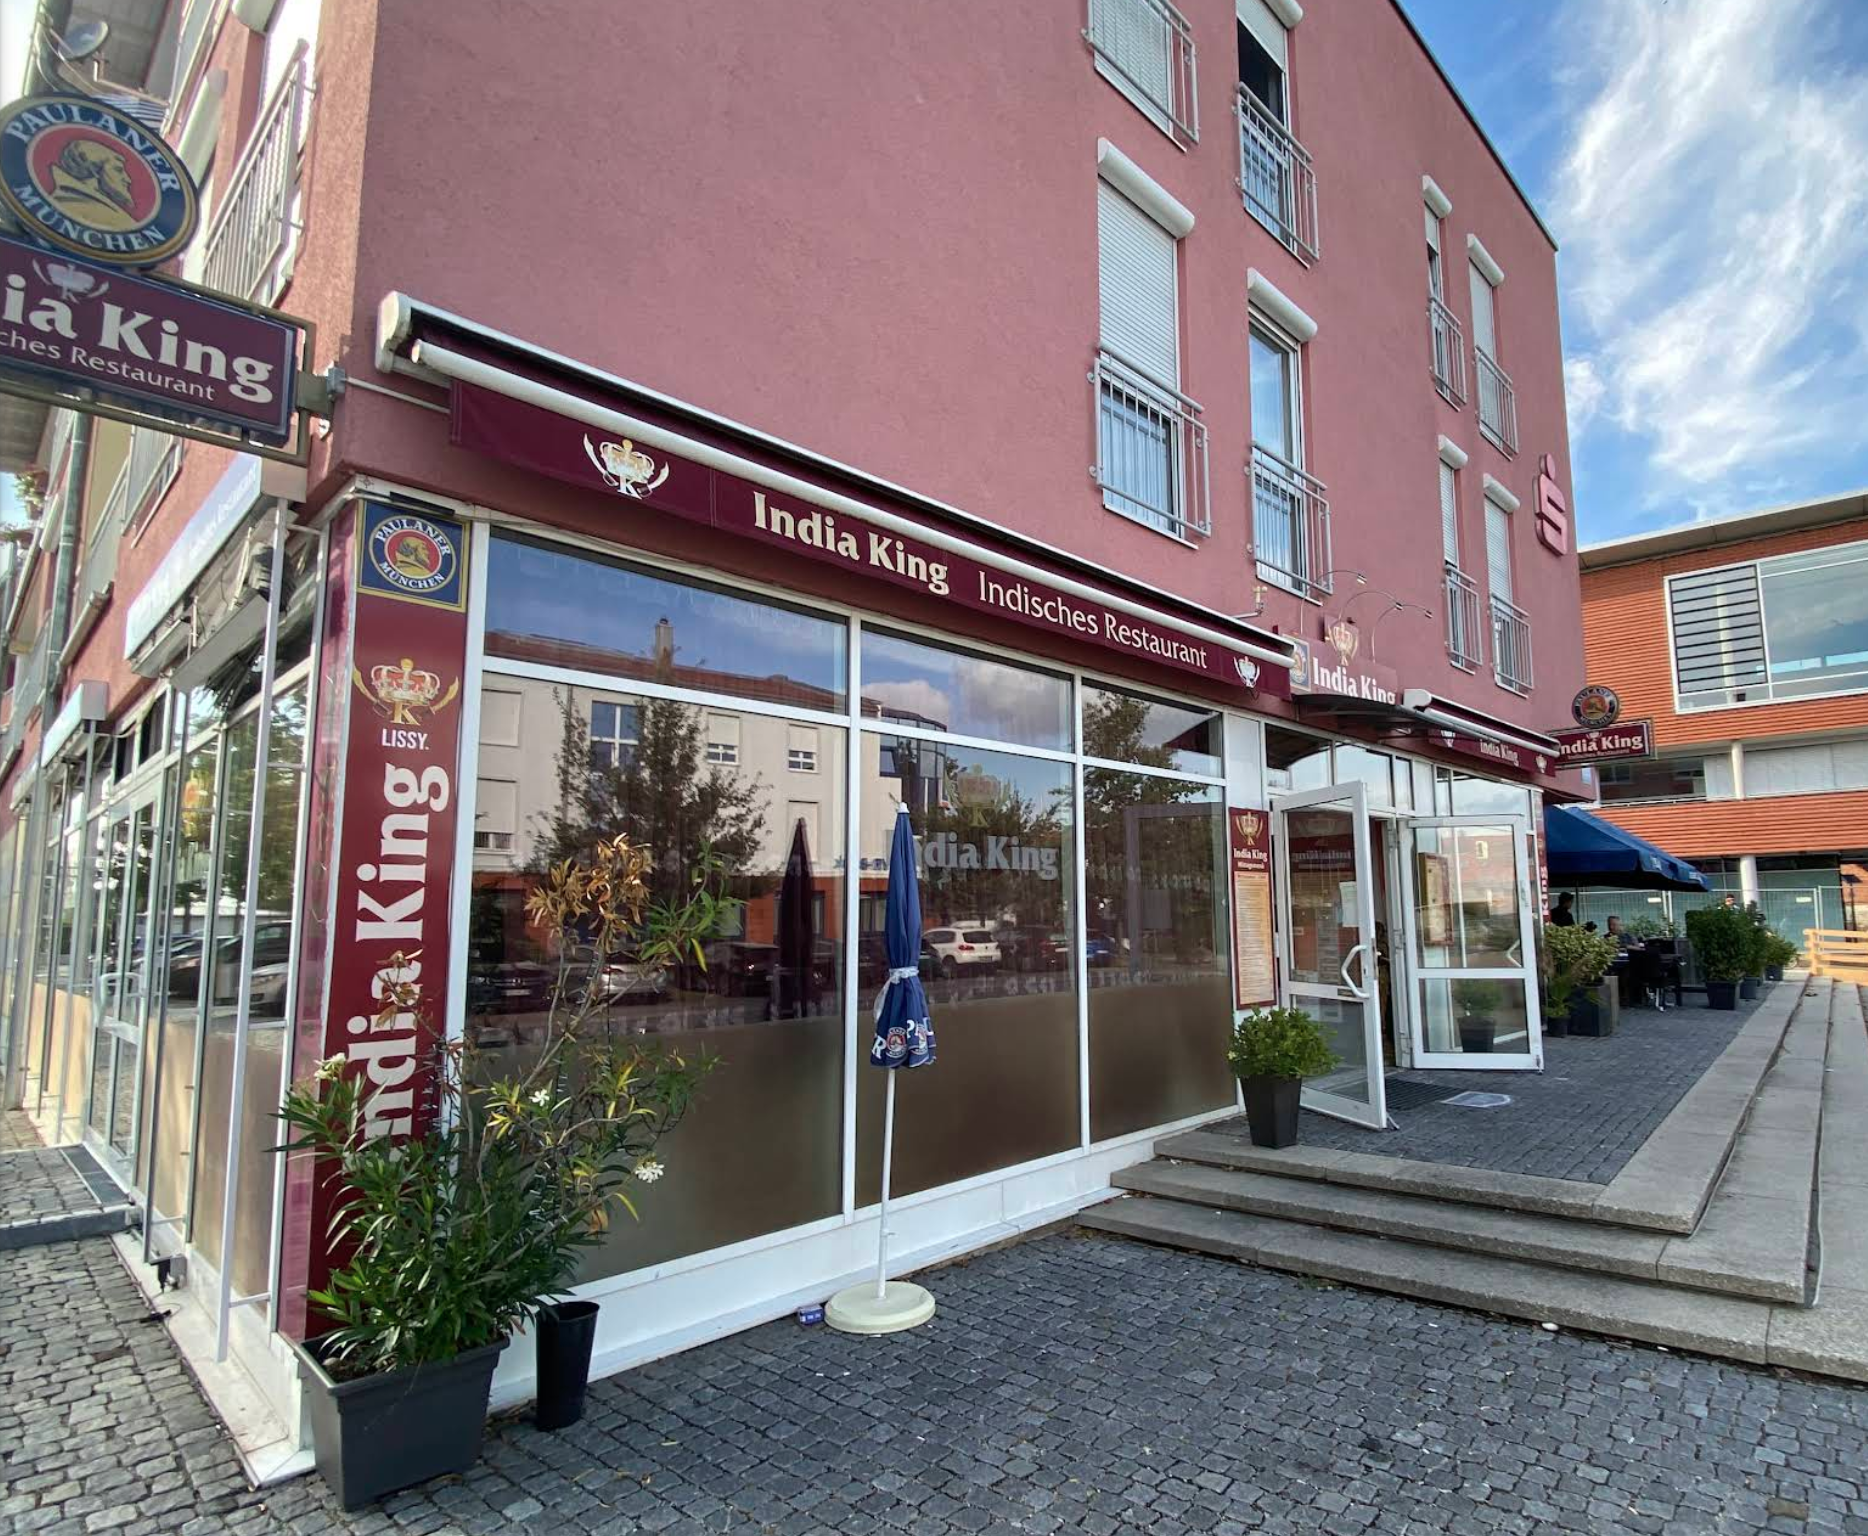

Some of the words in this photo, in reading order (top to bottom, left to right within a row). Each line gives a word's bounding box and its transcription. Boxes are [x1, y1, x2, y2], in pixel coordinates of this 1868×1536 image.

[5, 102, 181, 191] PAULANER
[71, 345, 215, 401] Restaurant
[98, 301, 274, 404] King
[375, 519, 451, 556] PAULANER
[753, 491, 860, 561] India
[868, 531, 950, 595] King
[978, 570, 1099, 635] Indisches
[1104, 612, 1207, 669] Restaurant
[1312, 656, 1359, 697] India
[1560, 738, 1599, 755] ndia
[1600, 734, 1644, 750] King
[355, 763, 450, 942] King
[986, 835, 1059, 881] King
[345, 959, 421, 1150] ndia
